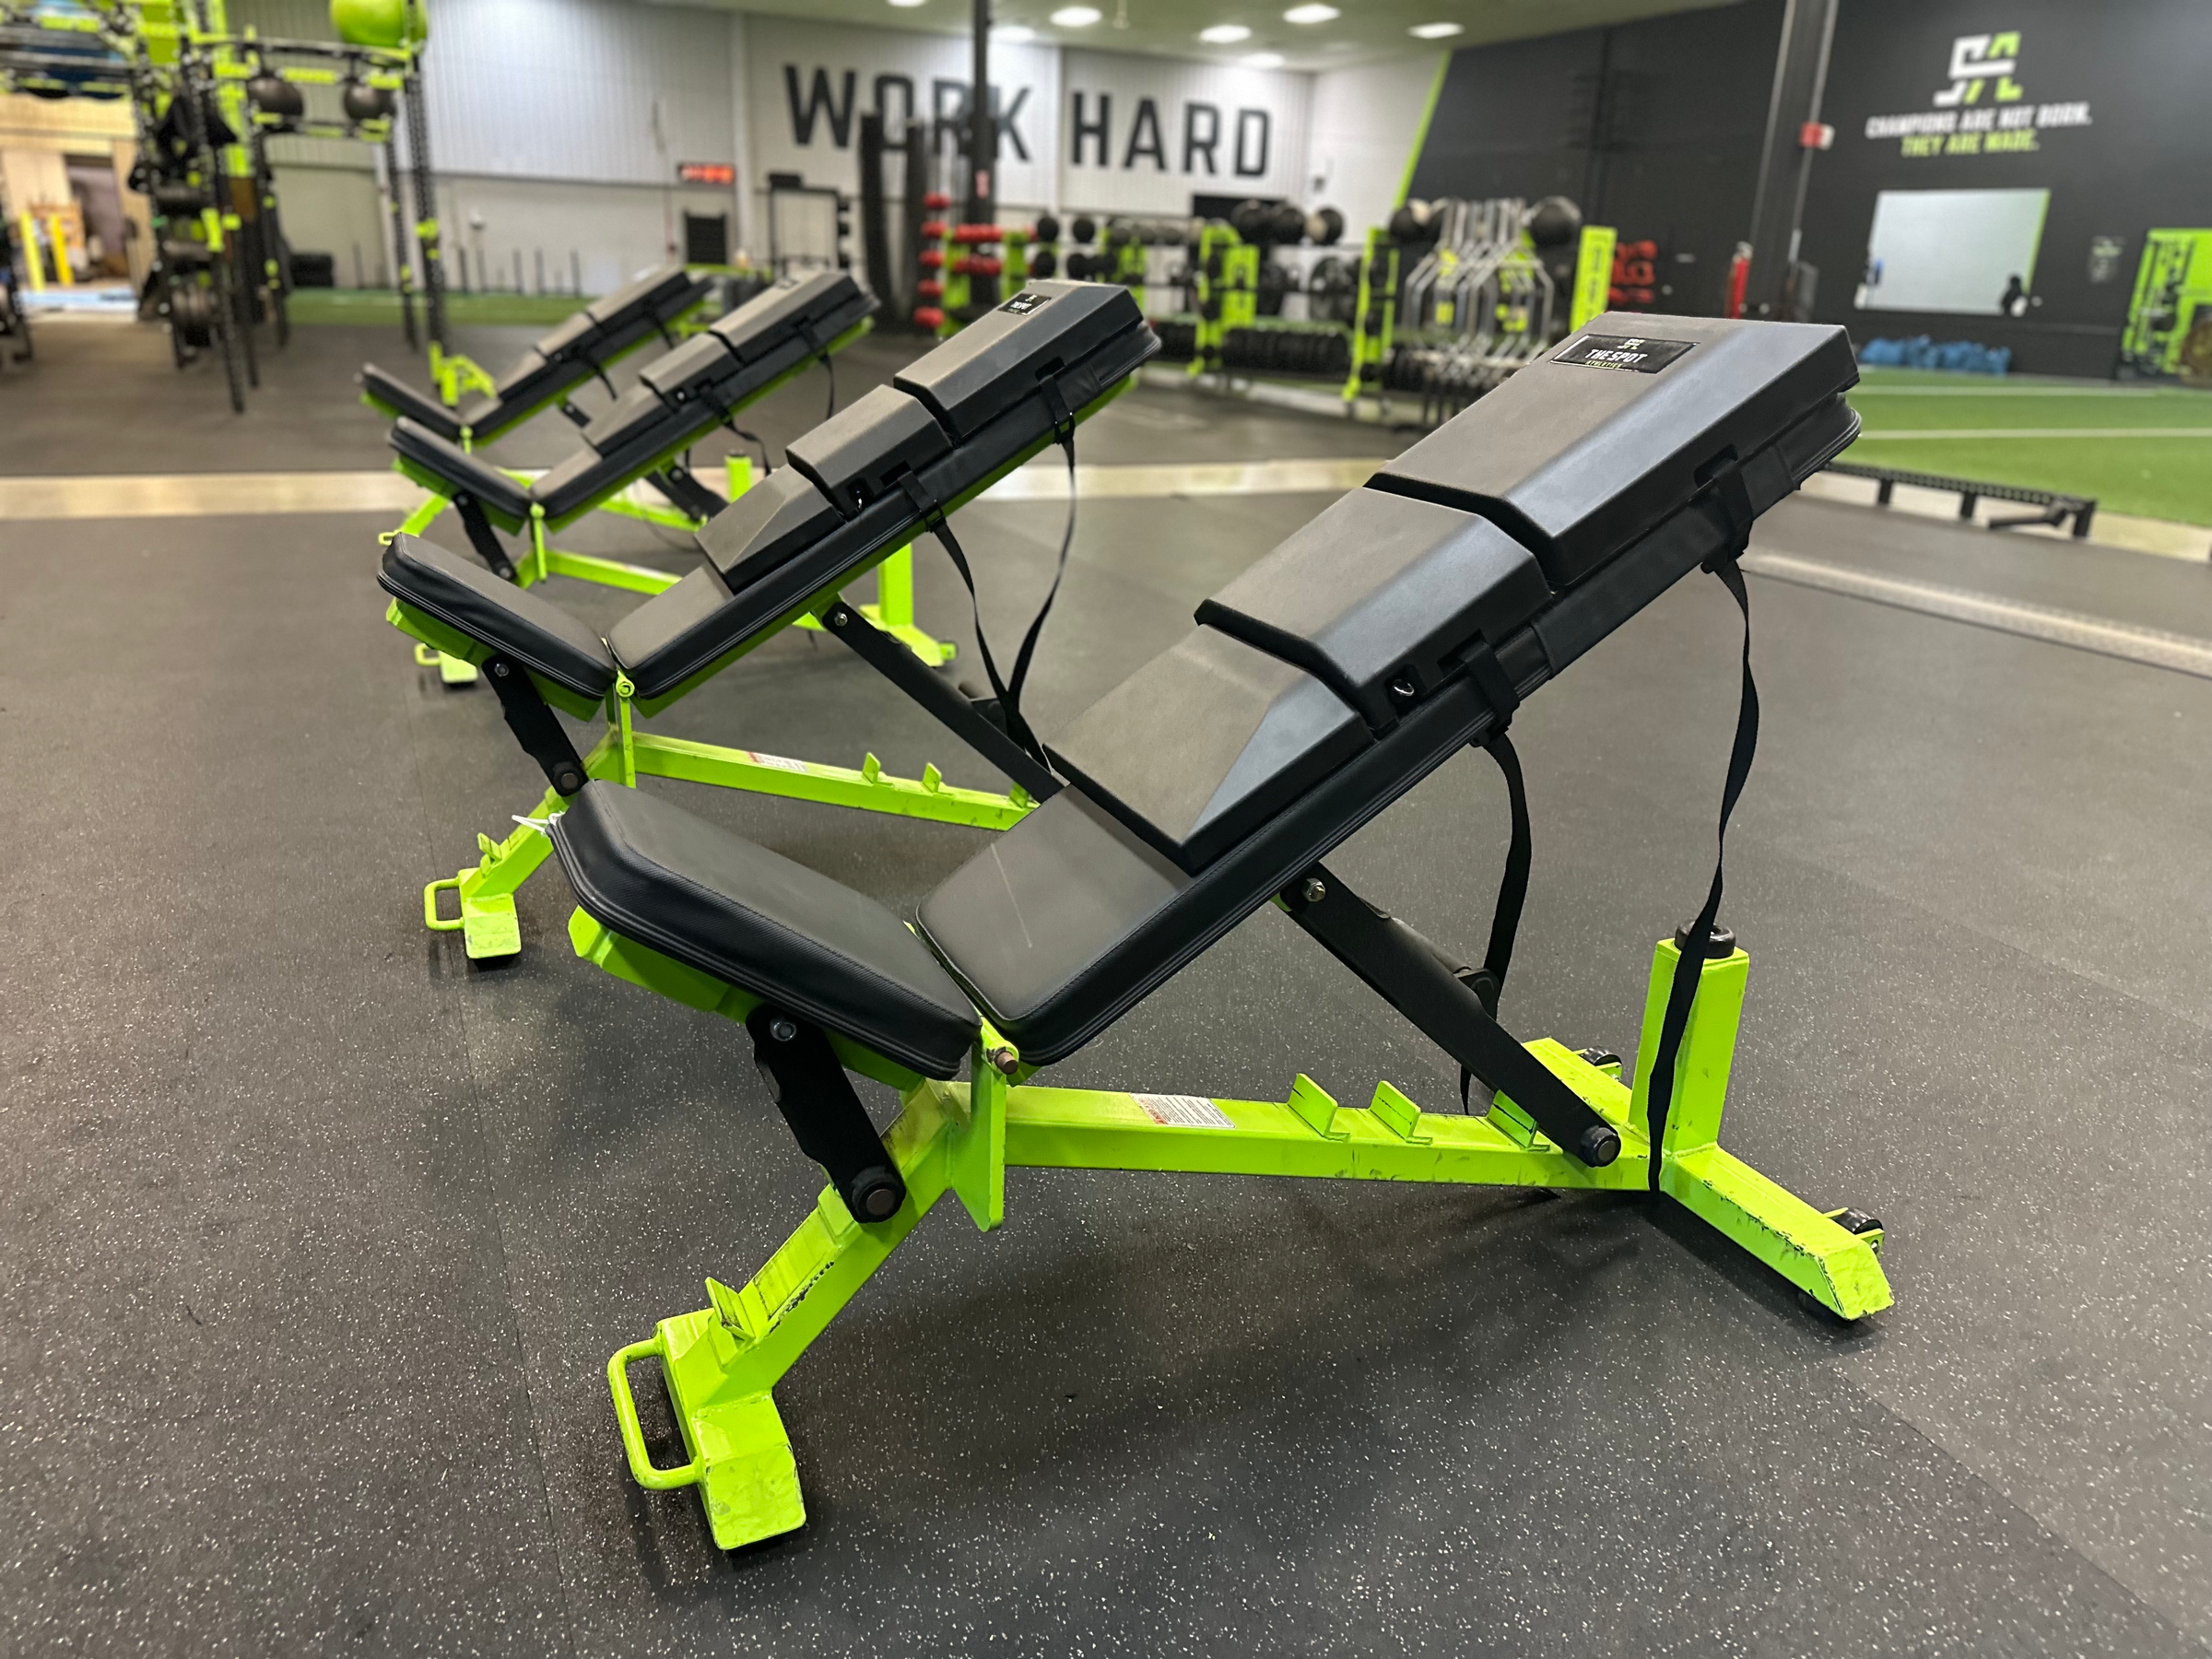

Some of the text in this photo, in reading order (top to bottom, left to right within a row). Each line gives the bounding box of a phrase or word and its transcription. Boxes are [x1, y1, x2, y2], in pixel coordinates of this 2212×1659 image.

[784, 64, 1270, 178] WORK HARD
[1865, 111, 1958, 138] CHAMPIONS
[1959, 108, 1996, 132] ARE
[1998, 105, 2035, 129] NOT
[1900, 134, 1944, 158] THEY
[1945, 132, 1983, 155] ARE
[1606, 351, 1648, 363] SPOT
